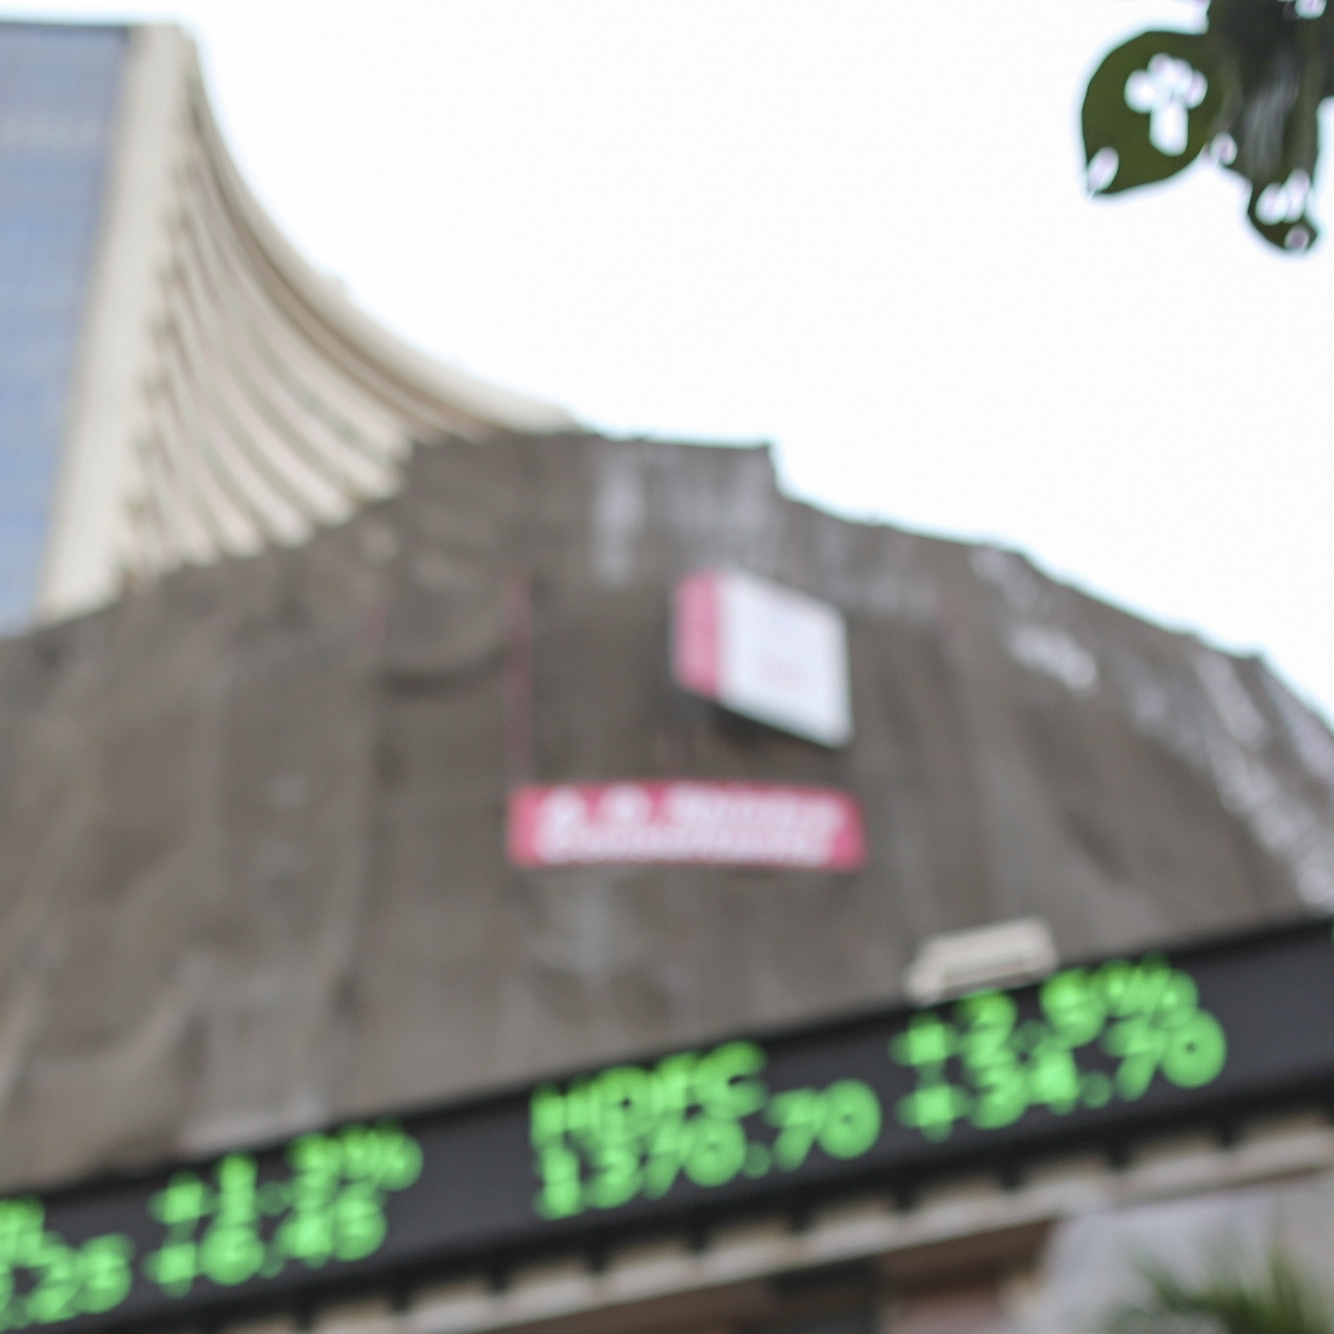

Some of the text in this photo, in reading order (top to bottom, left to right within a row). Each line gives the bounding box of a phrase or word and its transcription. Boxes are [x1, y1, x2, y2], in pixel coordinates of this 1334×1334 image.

[533, 1043, 763, 1152] HDFC
[536, 1009, 1226, 1218] 1370.70 +34.70
